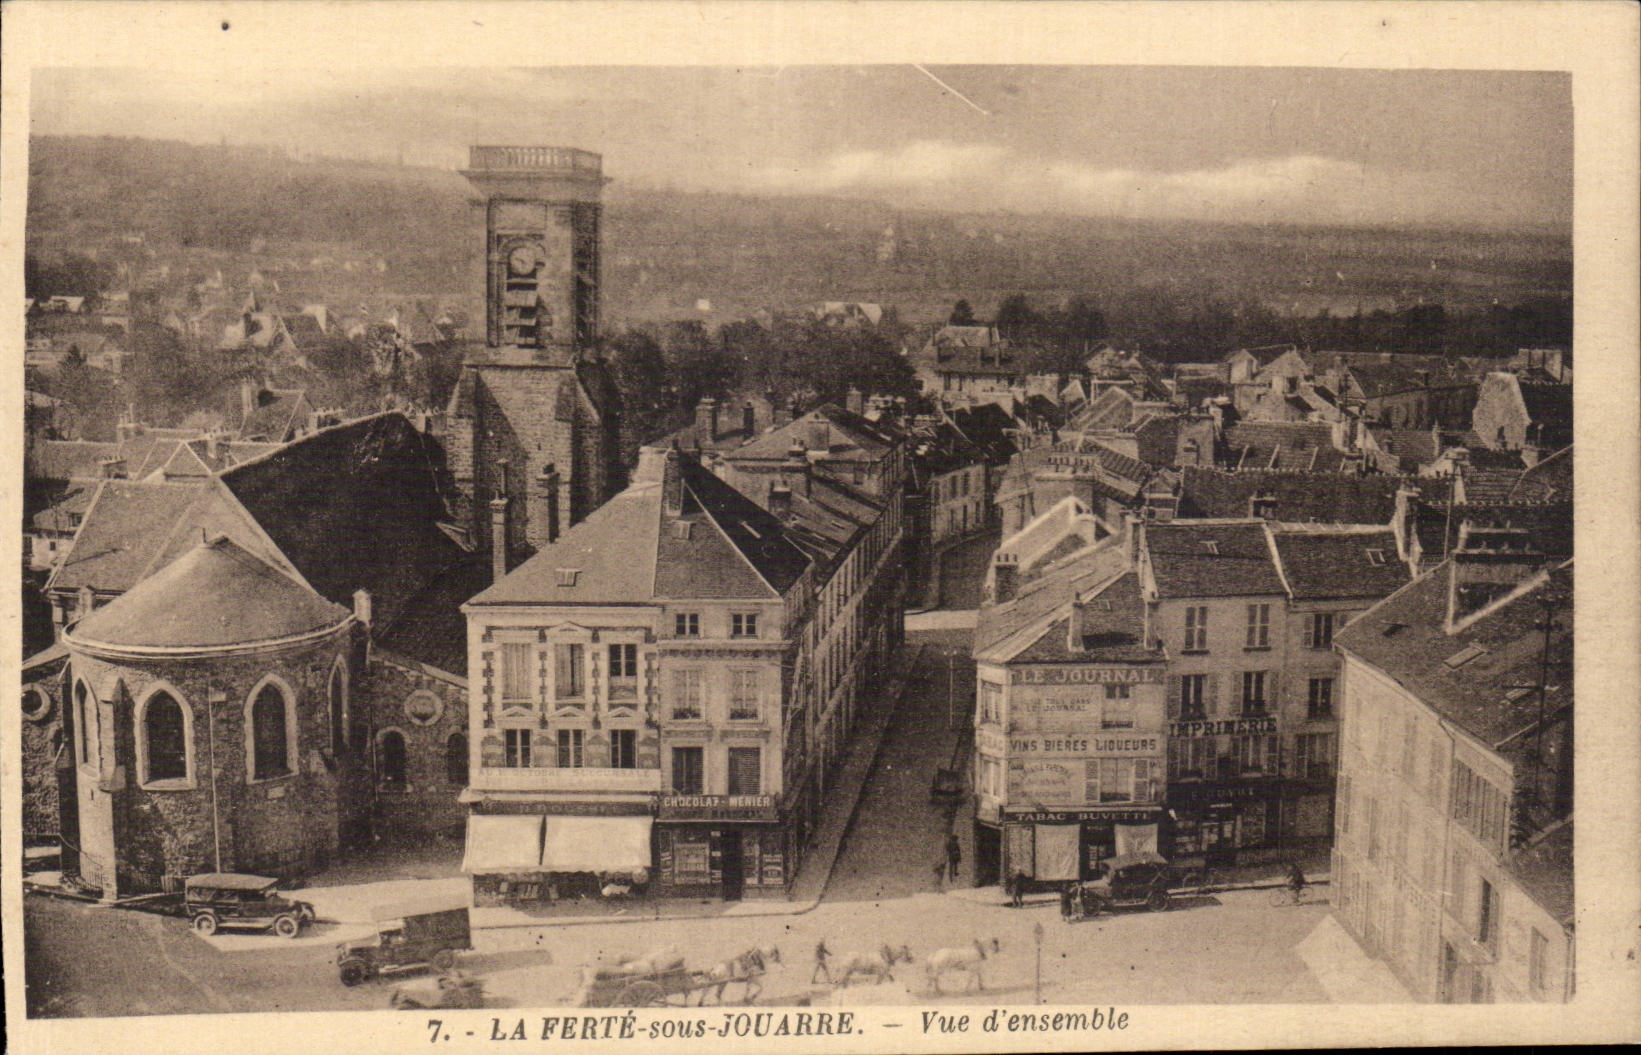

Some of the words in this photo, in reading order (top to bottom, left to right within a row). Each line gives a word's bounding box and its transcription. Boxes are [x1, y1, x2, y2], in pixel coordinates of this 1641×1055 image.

[1021, 670, 1045, 683] LE
[1055, 669, 1155, 683] JOURNAL
[1169, 718, 1277, 738] IMPRIMERIE
[1010, 739, 1037, 751] VINS
[1095, 738, 1157, 751] LIQUEURS
[664, 796, 719, 807] CHOCOLAT
[729, 796, 771, 807] MENIER
[1016, 813, 1067, 821] TABAC
